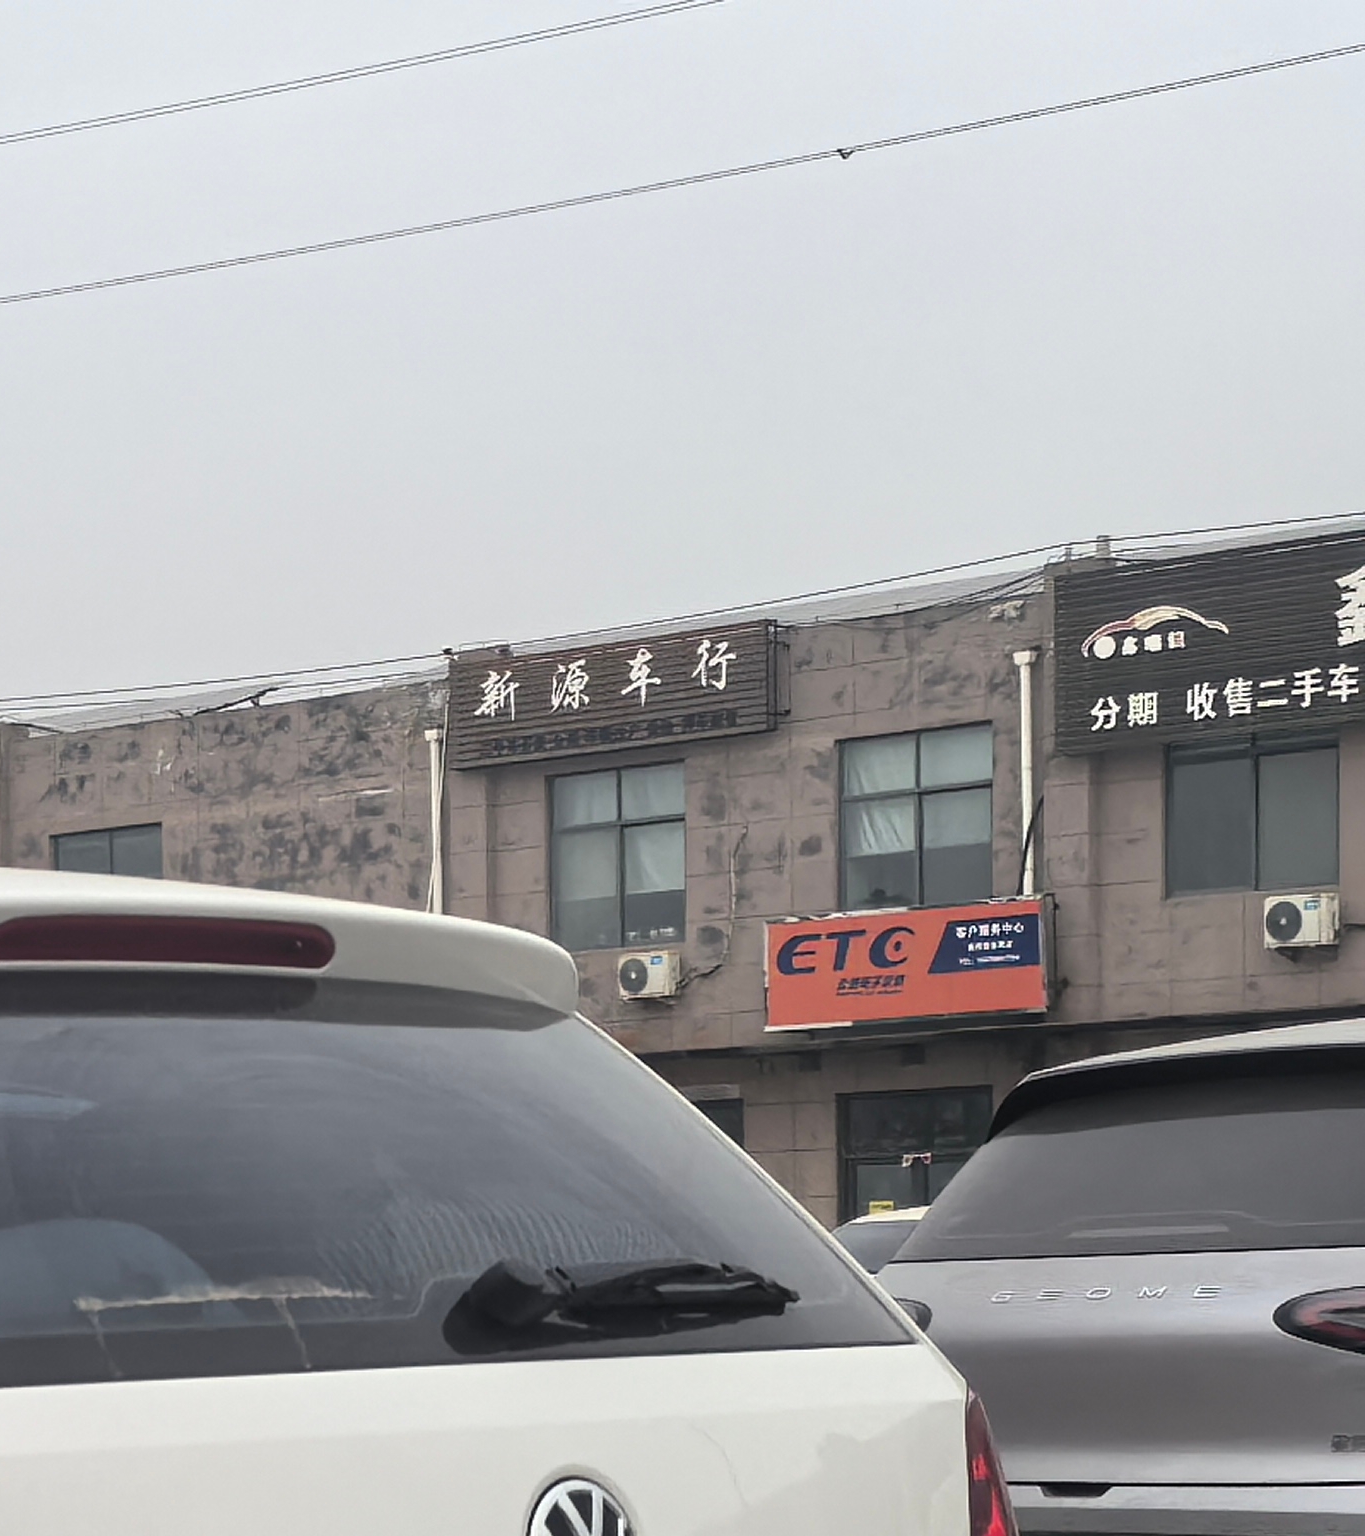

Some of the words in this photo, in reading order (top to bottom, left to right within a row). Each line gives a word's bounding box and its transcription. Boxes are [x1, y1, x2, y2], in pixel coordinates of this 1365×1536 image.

[474, 640, 737, 721] 新源车行
[1090, 690, 1159, 732] 分期
[1185, 662, 1360, 722] 收售二手车
[776, 926, 916, 976] ETC
[990, 1285, 1223, 1304] GEOME
